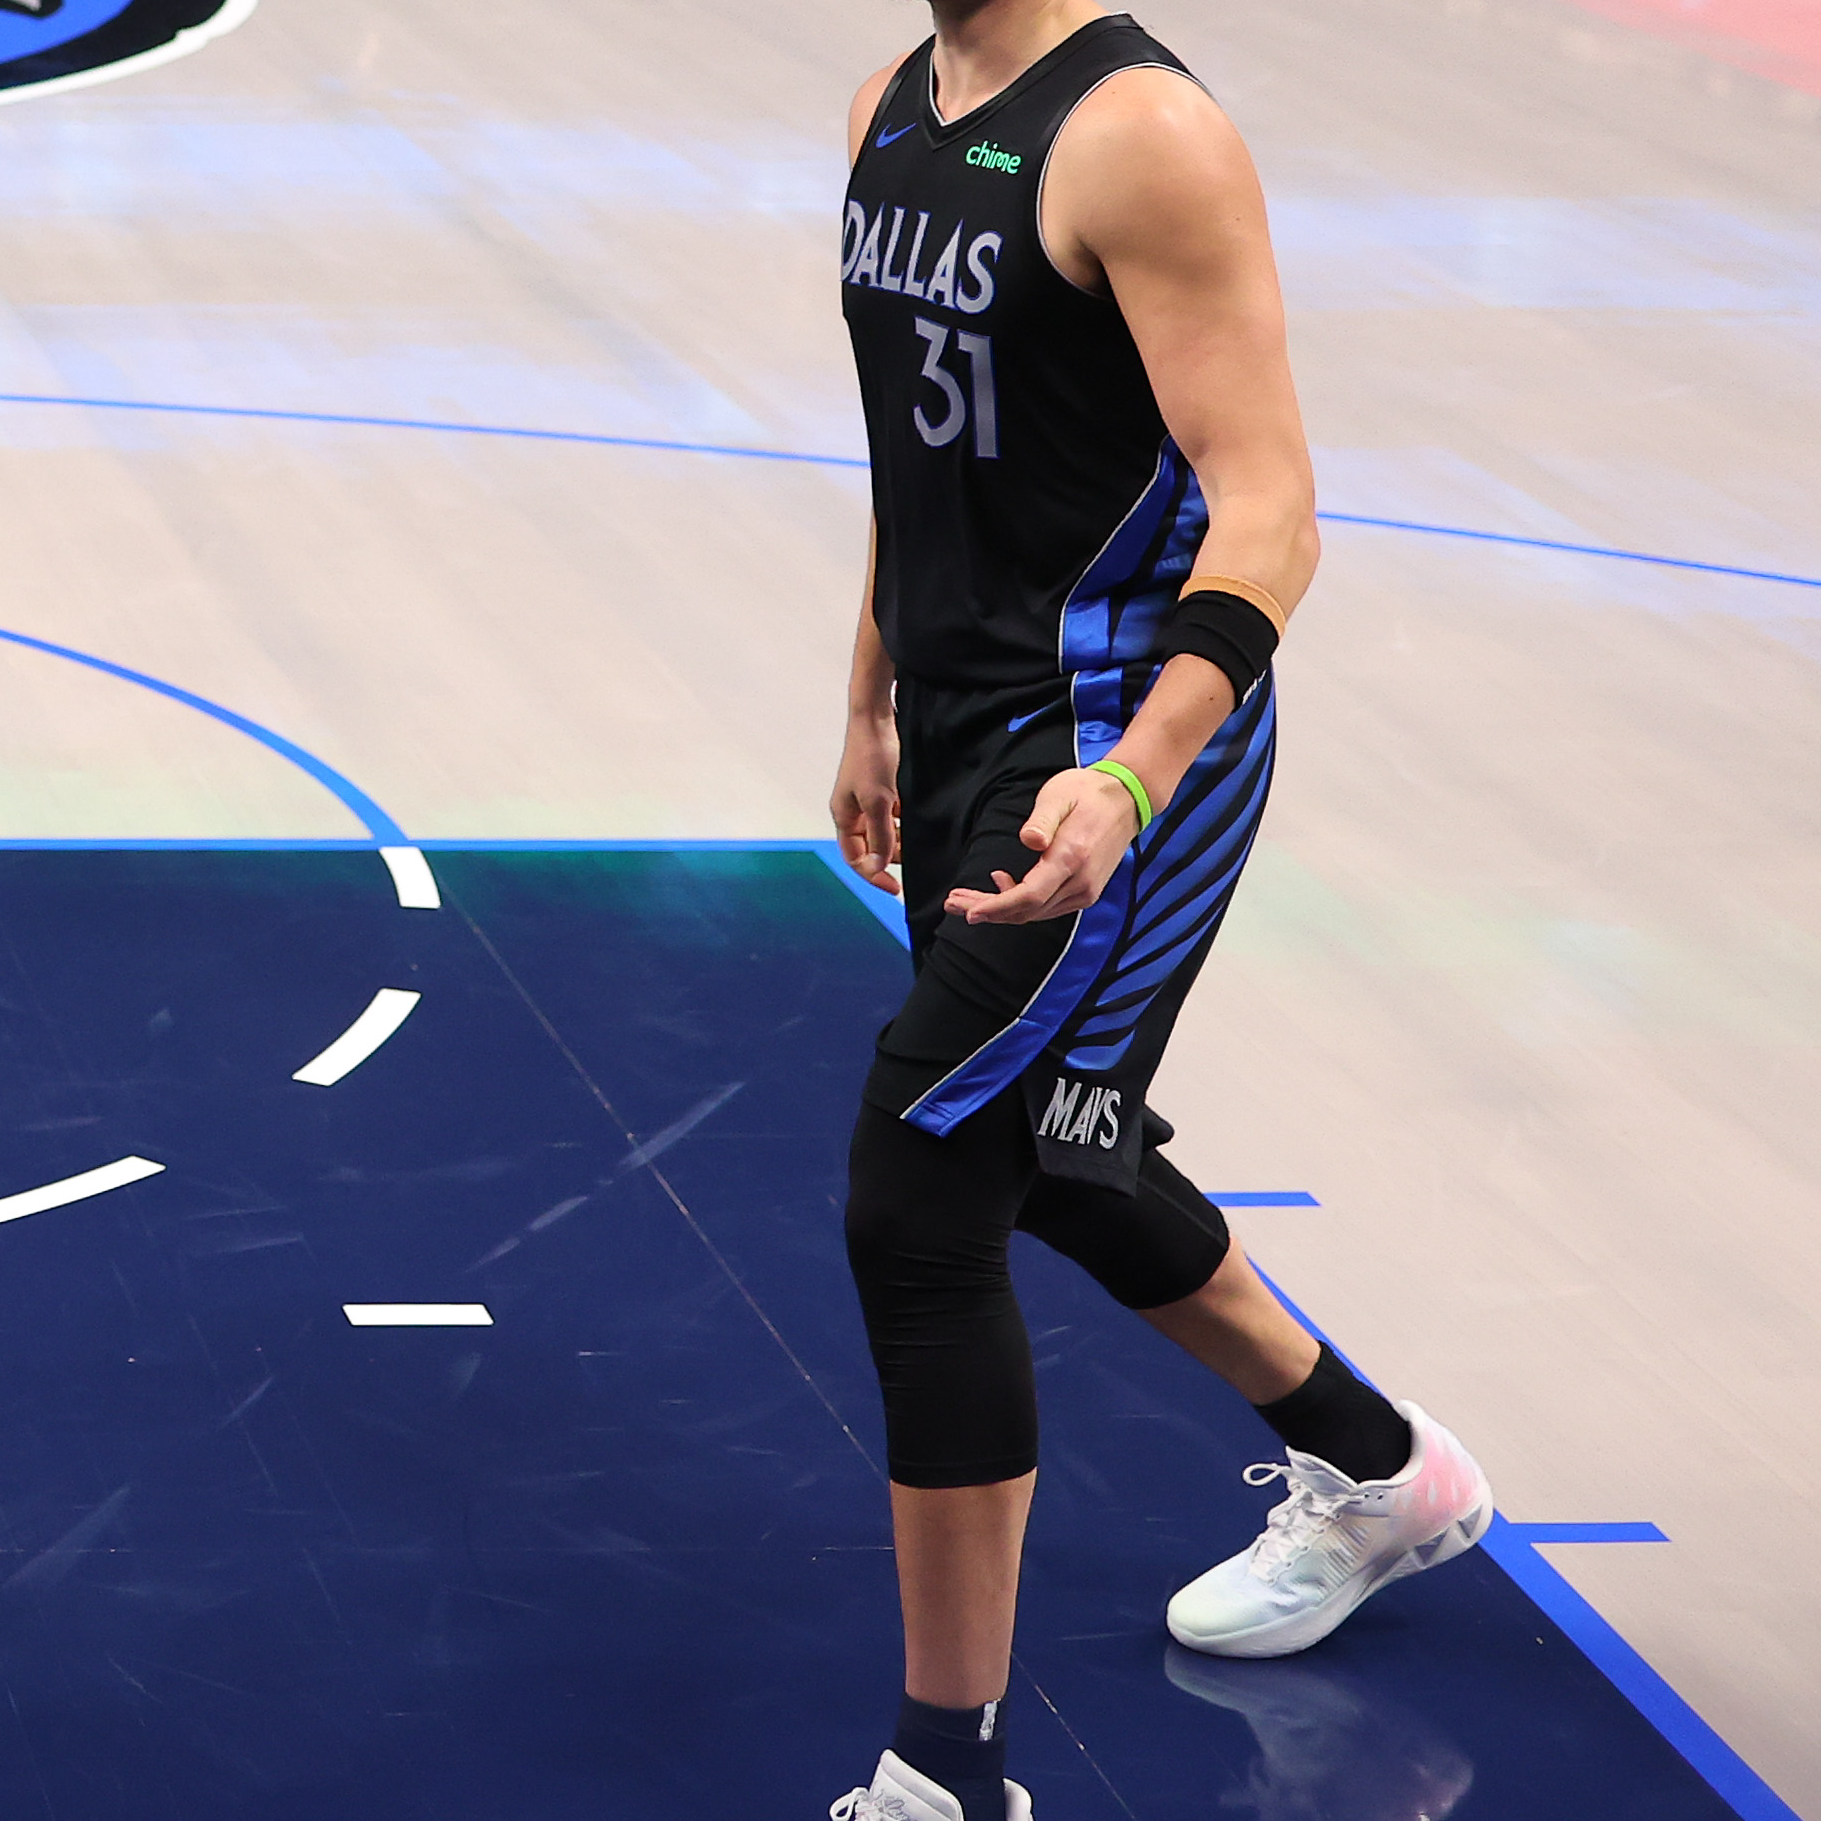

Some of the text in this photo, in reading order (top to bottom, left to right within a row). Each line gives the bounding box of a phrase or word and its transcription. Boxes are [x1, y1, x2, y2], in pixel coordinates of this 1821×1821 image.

[965, 139, 1022, 176] chime
[841, 199, 1004, 315] DALLAS
[912, 316, 1000, 460] 31
[1037, 1077, 1121, 1150] MAVS
